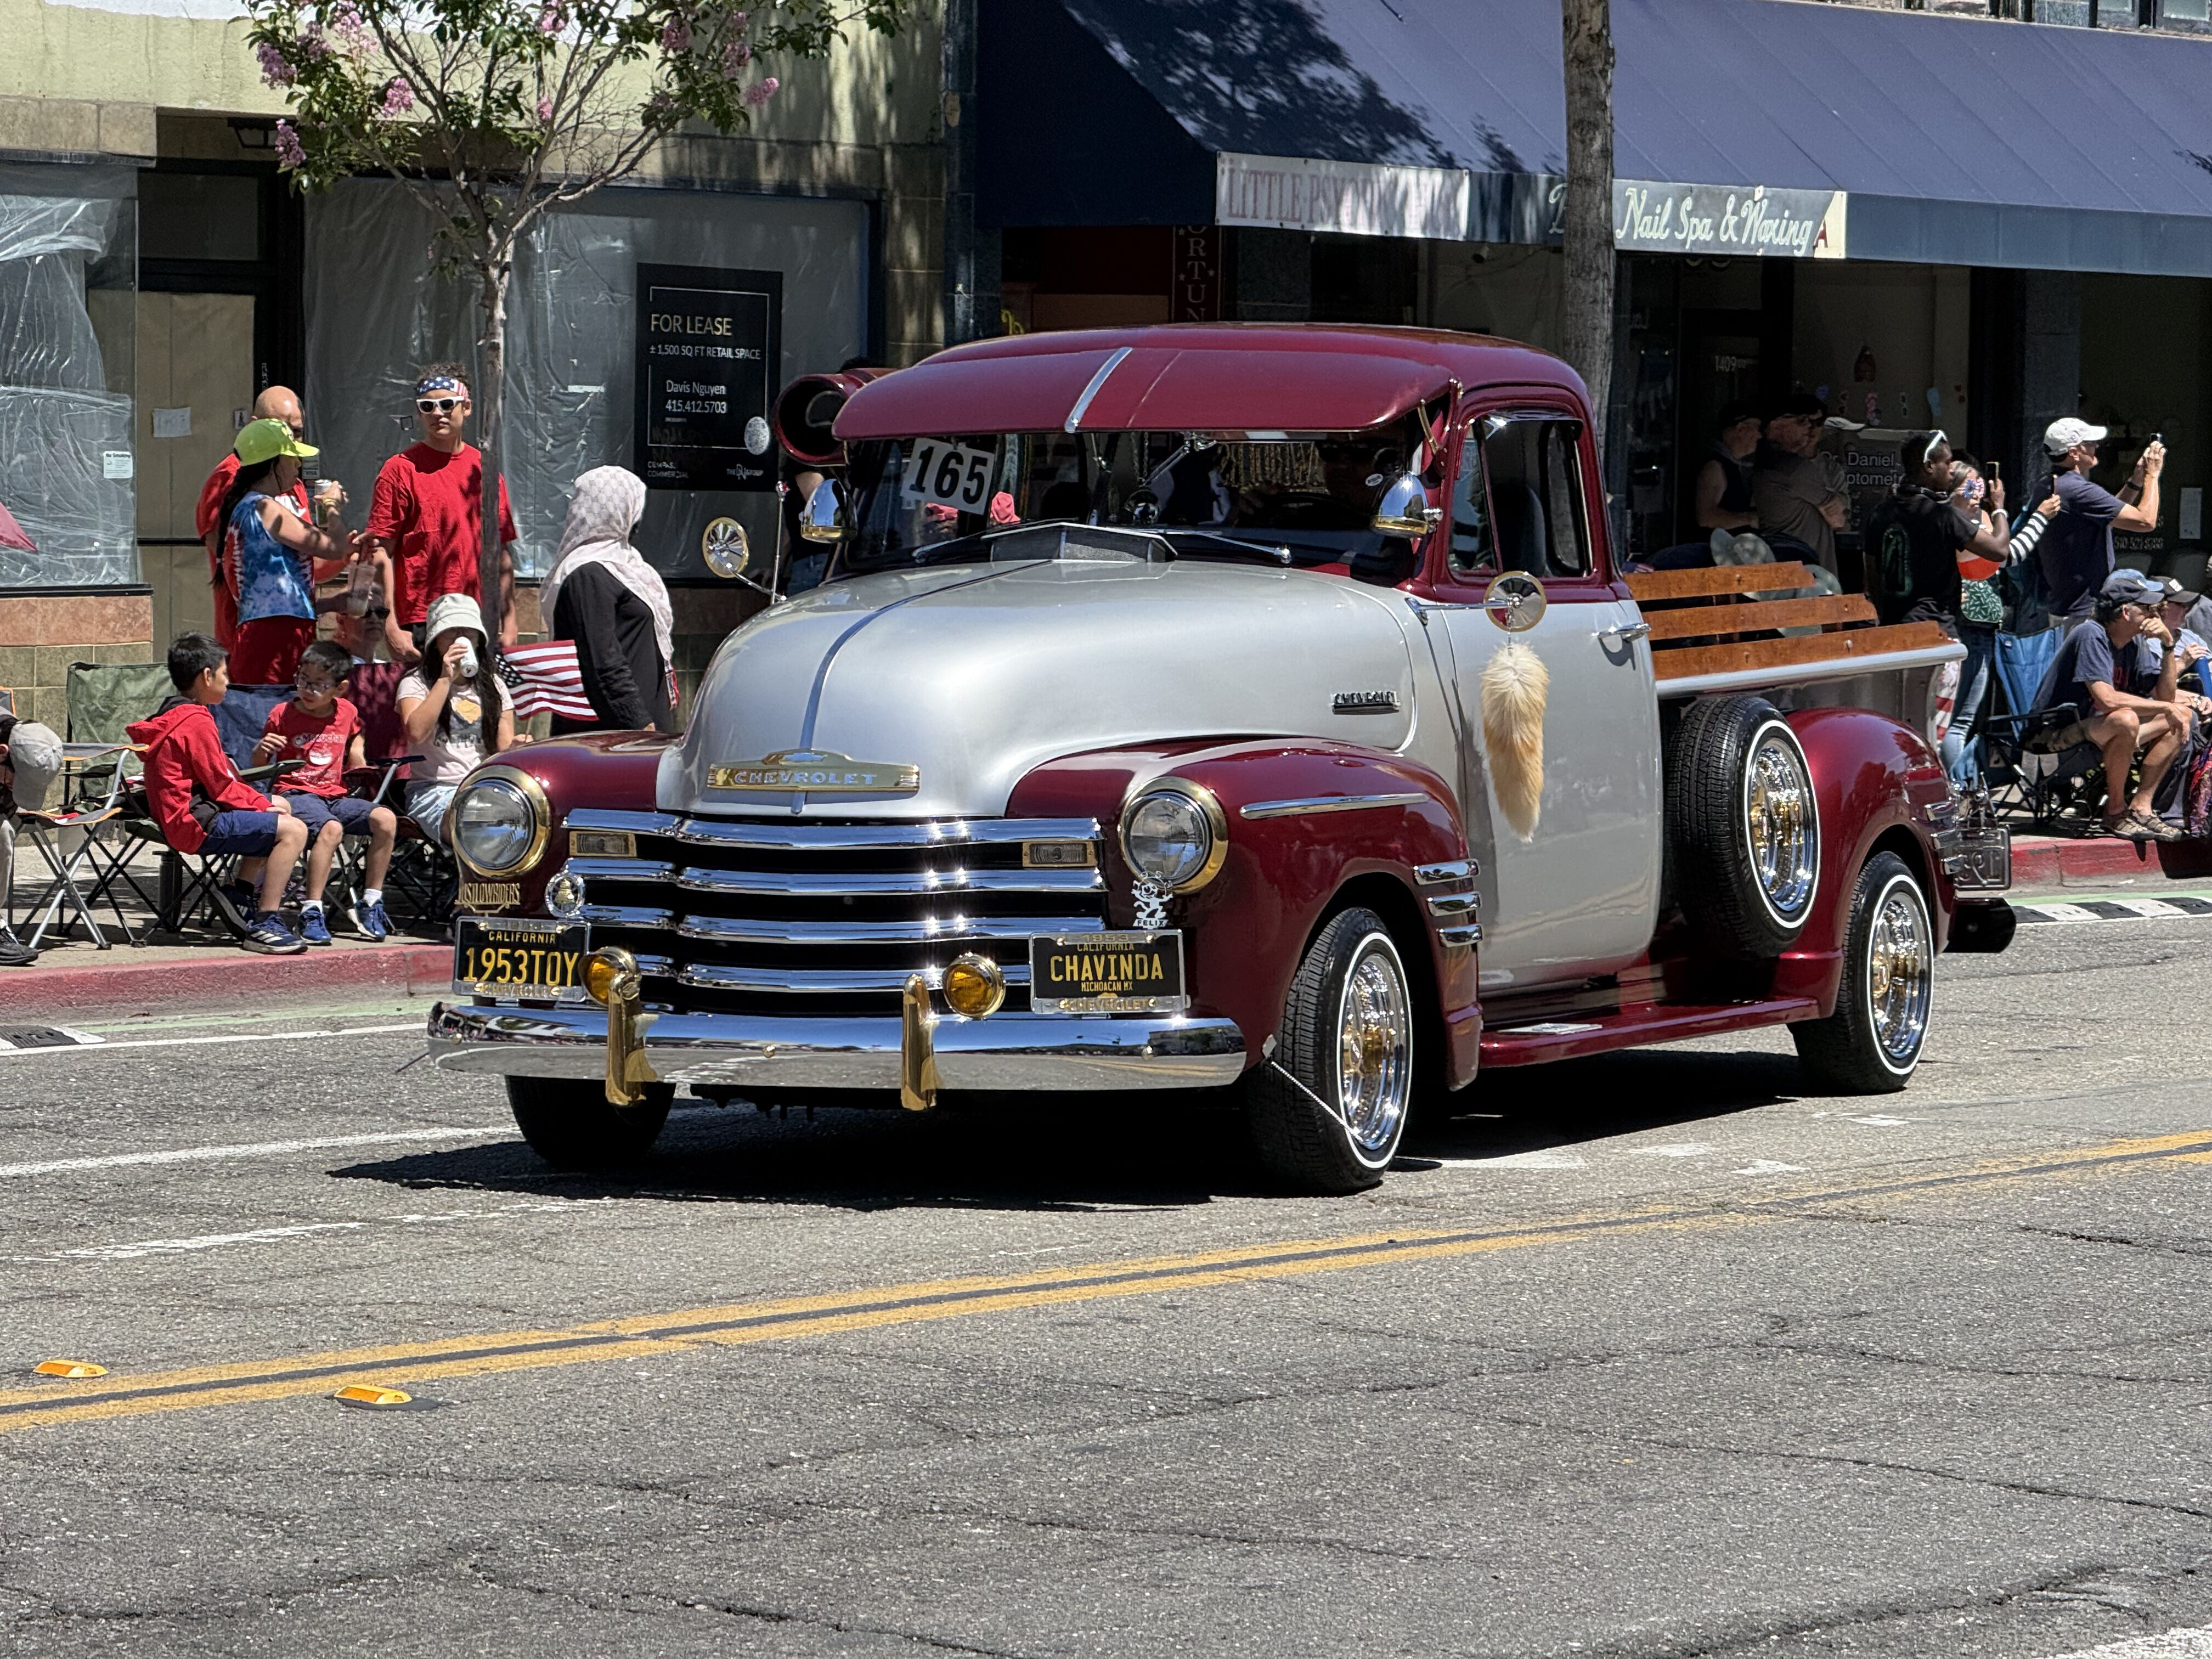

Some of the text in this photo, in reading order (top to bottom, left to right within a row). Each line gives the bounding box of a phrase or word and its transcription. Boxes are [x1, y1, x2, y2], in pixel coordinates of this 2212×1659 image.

[1616, 187, 1672, 240] Nail
[1675, 197, 1713, 250] Spa
[1720, 195, 1738, 242] &
[1741, 198, 1813, 256] Waxing
[651, 313, 733, 336] FOR LEASE
[658, 345, 679, 356] 1,500
[681, 346, 693, 358] SQ
[695, 347, 704, 357] FT
[707, 347, 733, 358] RETAIL
[735, 348, 761, 360] SPACE
[666, 380, 726, 397] Davis Nguyen
[665, 399, 727, 414] 415.412.5703
[1848, 452, 1894, 467] Daniel
[909, 445, 988, 505] 165
[734, 771, 876, 785] CHEVROLET
[489, 930, 556, 944] CALIFORNIA
[1082, 934, 1130, 943] 1953
[1076, 943, 1135, 952] CALIFORNIA
[463, 947, 579, 987] 1953TOY
[1050, 953, 1163, 981] CHAVINDA
[1081, 981, 1133, 992] MICHOACAN MX
